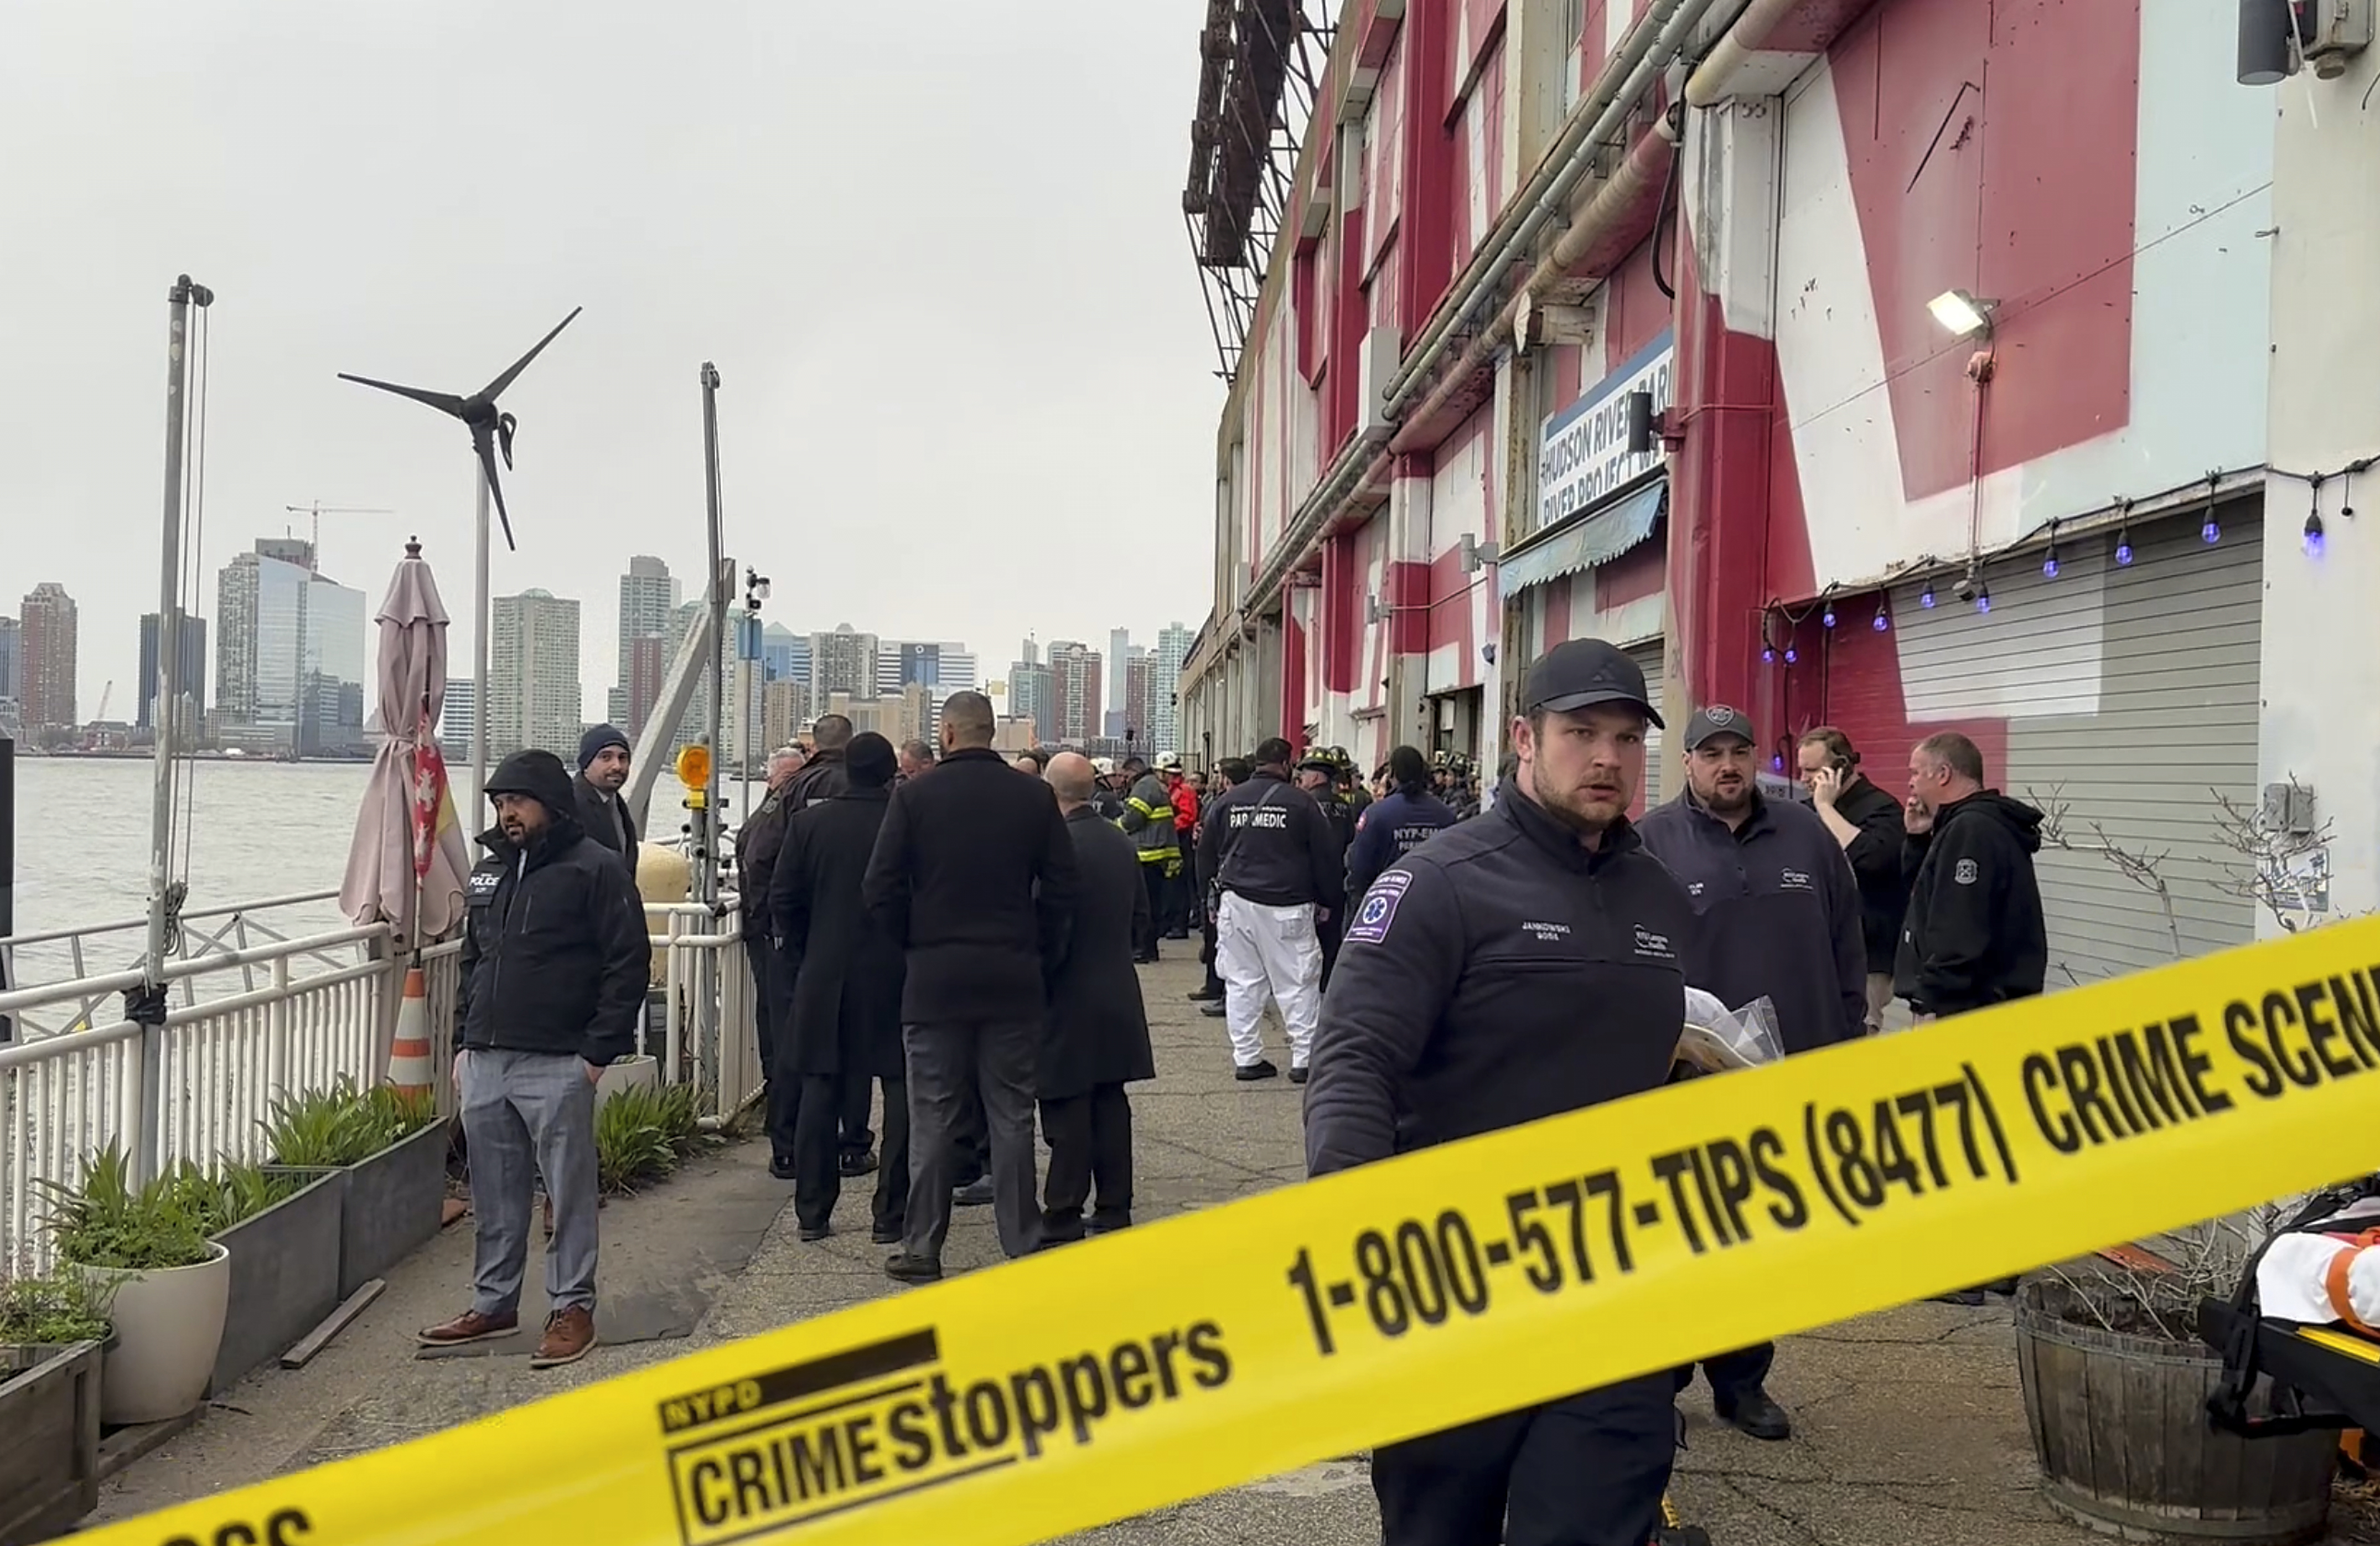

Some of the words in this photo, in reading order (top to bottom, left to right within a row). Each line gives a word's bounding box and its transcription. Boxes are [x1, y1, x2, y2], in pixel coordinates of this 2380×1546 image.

[1545, 418, 1592, 488] HUDSON
[1289, 1129, 1808, 1354] 1-800-577-TIPS
[1804, 1063, 2017, 1226] (8477)
[2021, 1014, 2234, 1154] CRIME
[665, 1379, 762, 1428] NYPD
